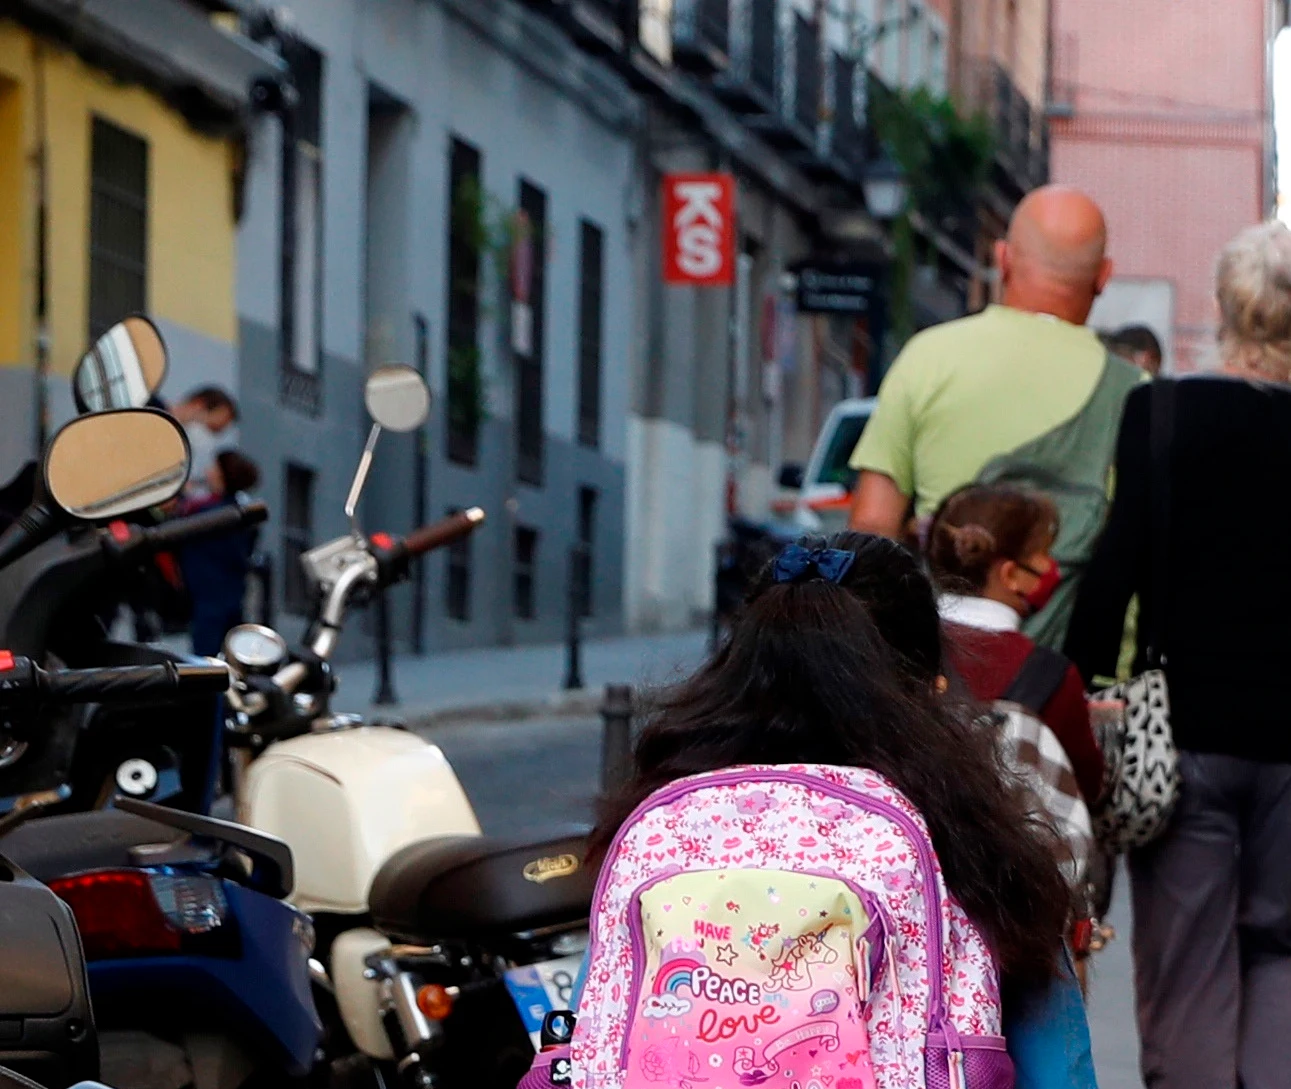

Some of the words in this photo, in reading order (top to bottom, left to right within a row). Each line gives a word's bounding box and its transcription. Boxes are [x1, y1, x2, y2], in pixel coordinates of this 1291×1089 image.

[673, 181, 724, 278] KS
[671, 936, 705, 953] FUN
[694, 920, 732, 941] HAVE
[696, 1005, 781, 1043] love
